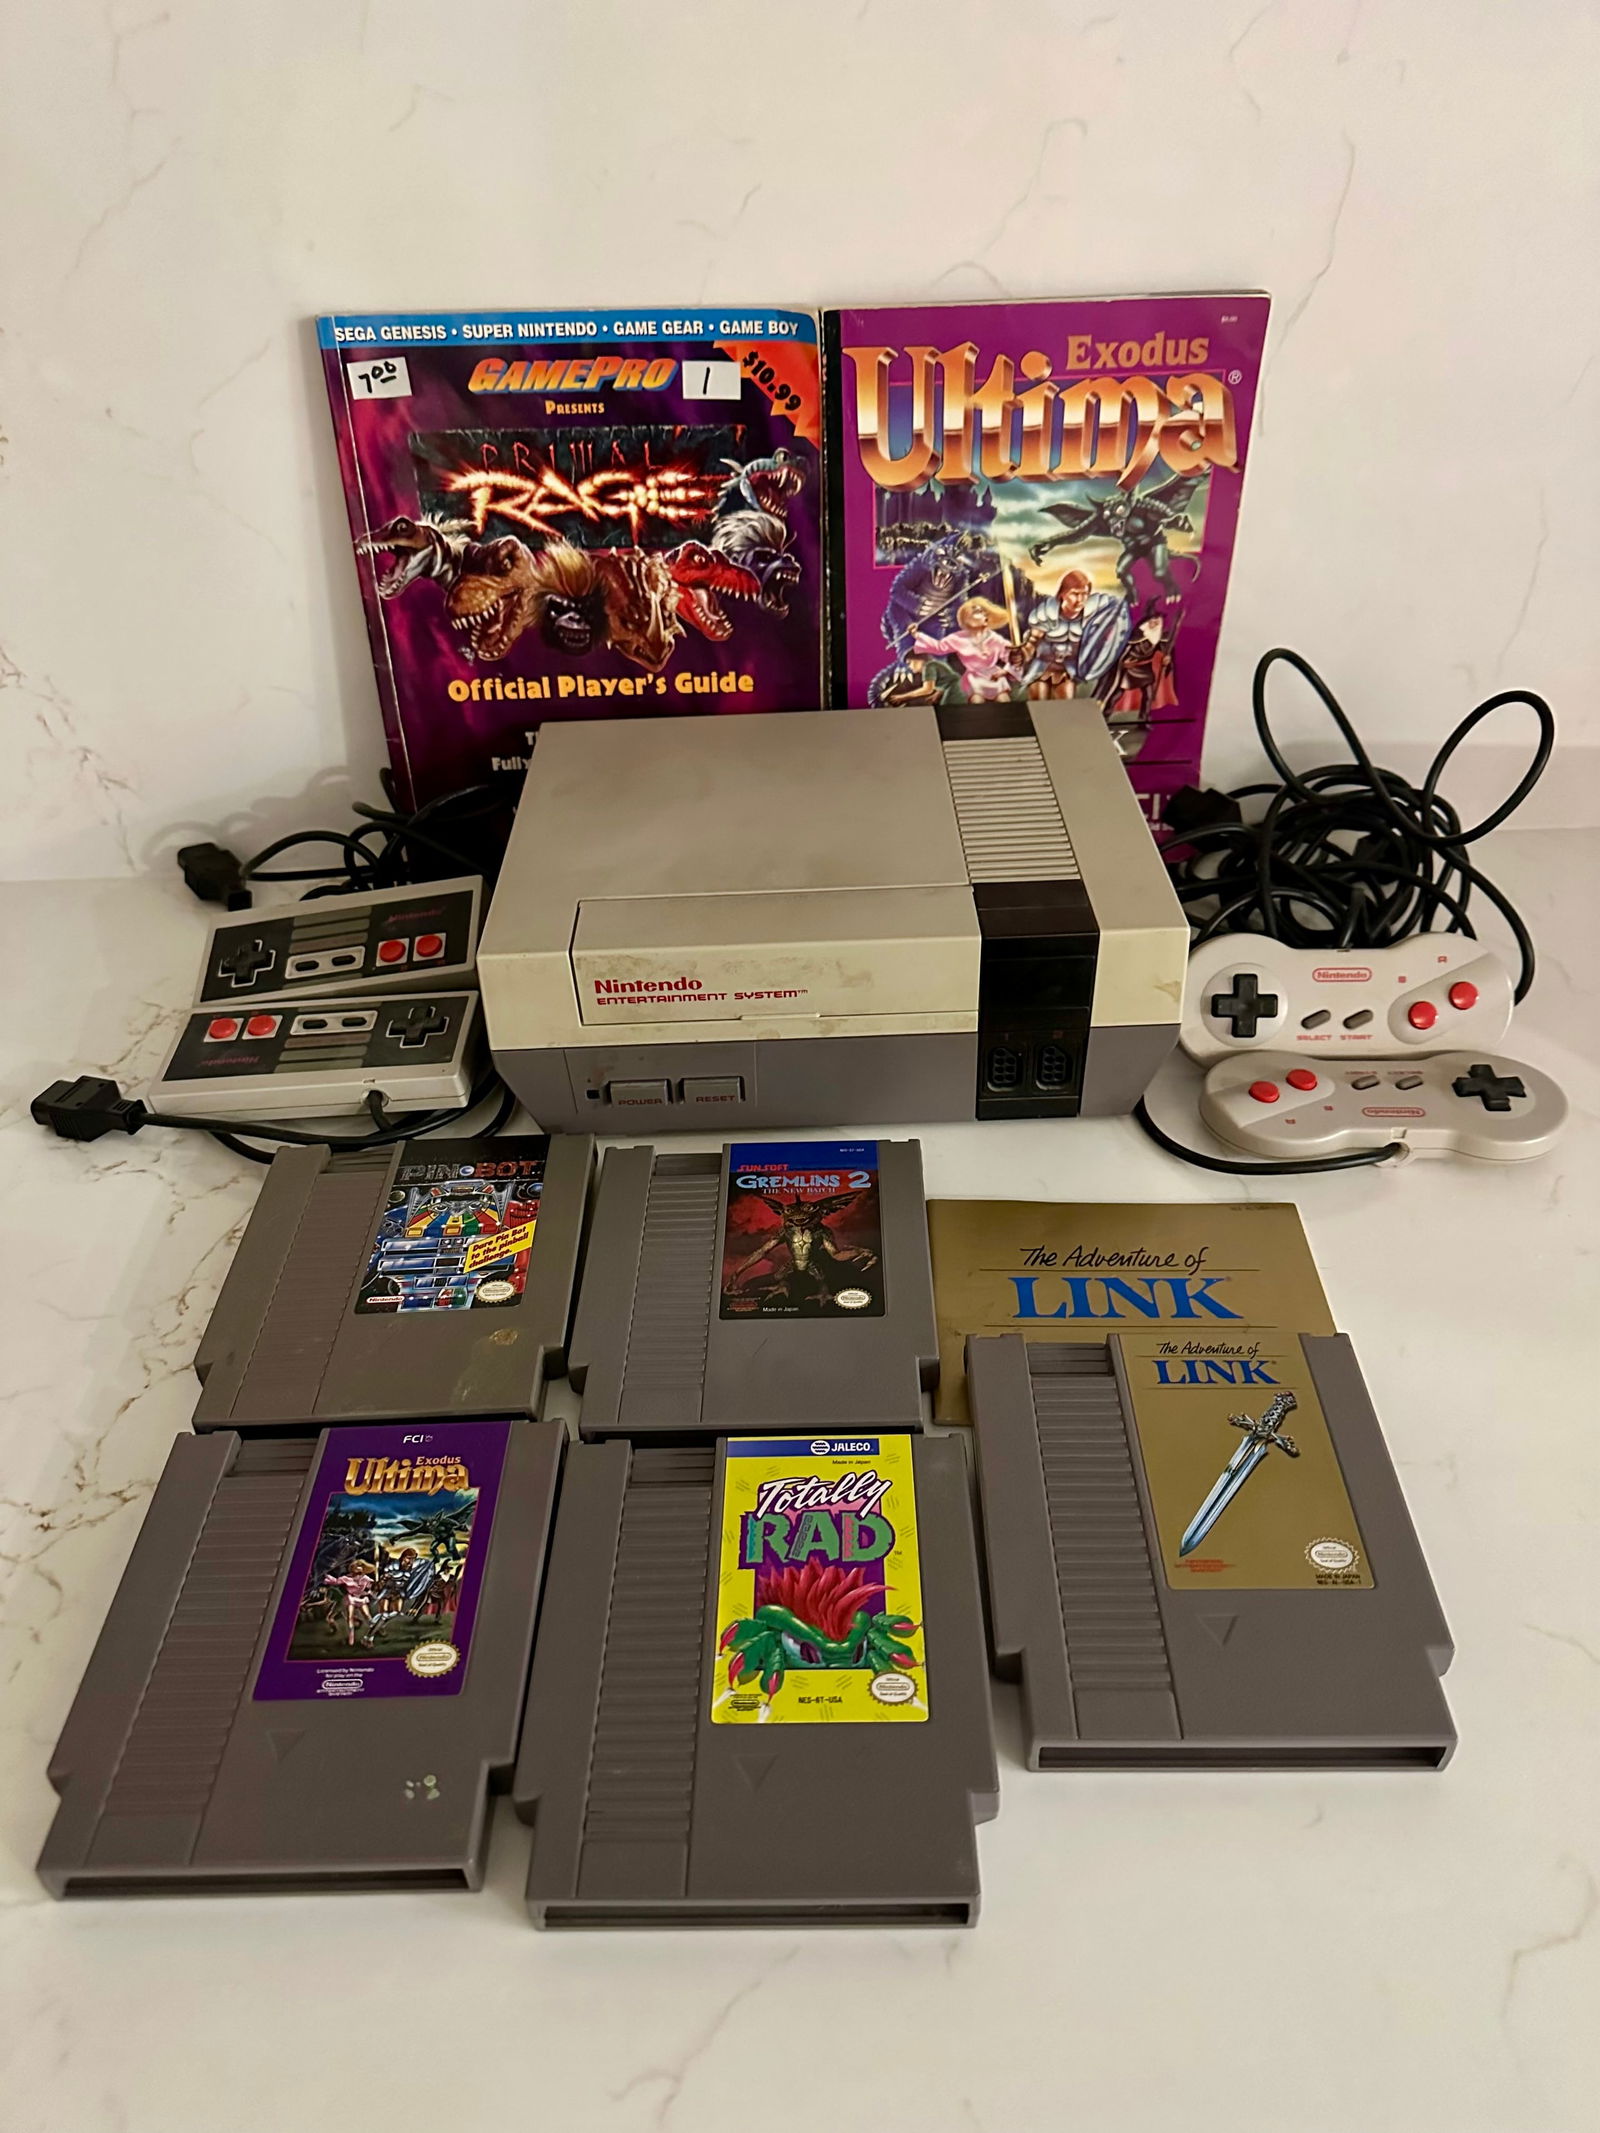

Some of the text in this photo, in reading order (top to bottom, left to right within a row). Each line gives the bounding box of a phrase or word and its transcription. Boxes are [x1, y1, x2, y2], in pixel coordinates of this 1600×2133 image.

[335, 320, 799, 342] SEGA GENESIS SUPER NINTENDO GAME GEAR GAME BOY
[1065, 331, 1209, 371] Exodus
[468, 356, 678, 393] GAMEPRO
[743, 351, 802, 412] $10.99
[545, 400, 605, 415] PRESENTS
[448, 671, 755, 702] Official Player's Guide
[594, 977, 703, 994] Nintendo
[1317, 971, 1367, 979] Nintendo
[597, 993, 727, 1006] ENTERTAINMENT
[618, 1095, 736, 1106] POWER RESET
[737, 1164, 789, 1173] SUNSOFT
[736, 1171, 872, 1189] GREMLINS 2
[471, 1232, 529, 1260] to the pinball
[473, 1226, 526, 1252] Dare Pin Bot
[469, 1248, 512, 1268] challenge.
[1020, 1245, 1209, 1275] The Adventure of
[1008, 1277, 1244, 1319] LINK
[1157, 1341, 1261, 1359] The Adventure of
[1152, 1360, 1281, 1384] LINK
[403, 1434, 424, 1444] FCI
[831, 1442, 871, 1452] JALECO
[416, 1456, 461, 1466] Exodus
[344, 1456, 469, 1497] Ultima
[758, 1470, 893, 1521] Totally
[738, 1511, 896, 1570] RAD
